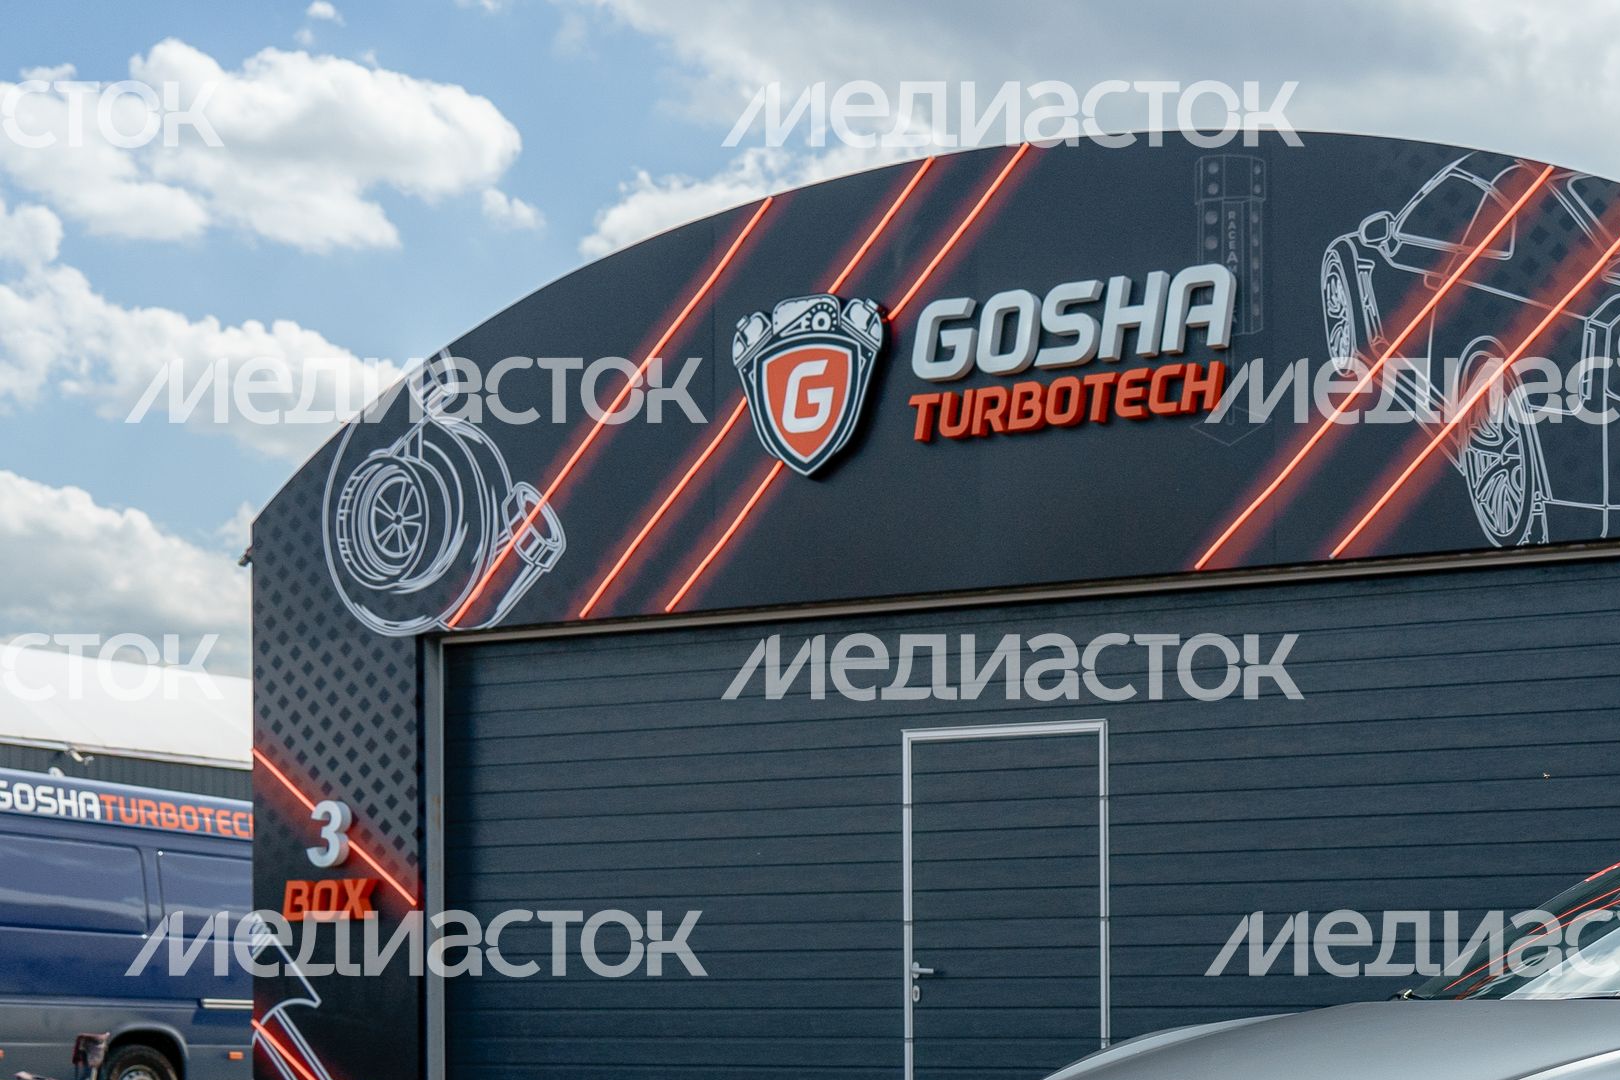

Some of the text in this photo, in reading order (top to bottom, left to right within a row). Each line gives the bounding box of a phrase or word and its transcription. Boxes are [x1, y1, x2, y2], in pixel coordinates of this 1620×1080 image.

[911, 263, 1237, 382] GOSHA
[782, 359, 834, 434] G
[908, 361, 1226, 443] TURBOTECH
[306, 800, 352, 868] 3
[282, 878, 379, 922] BOX
